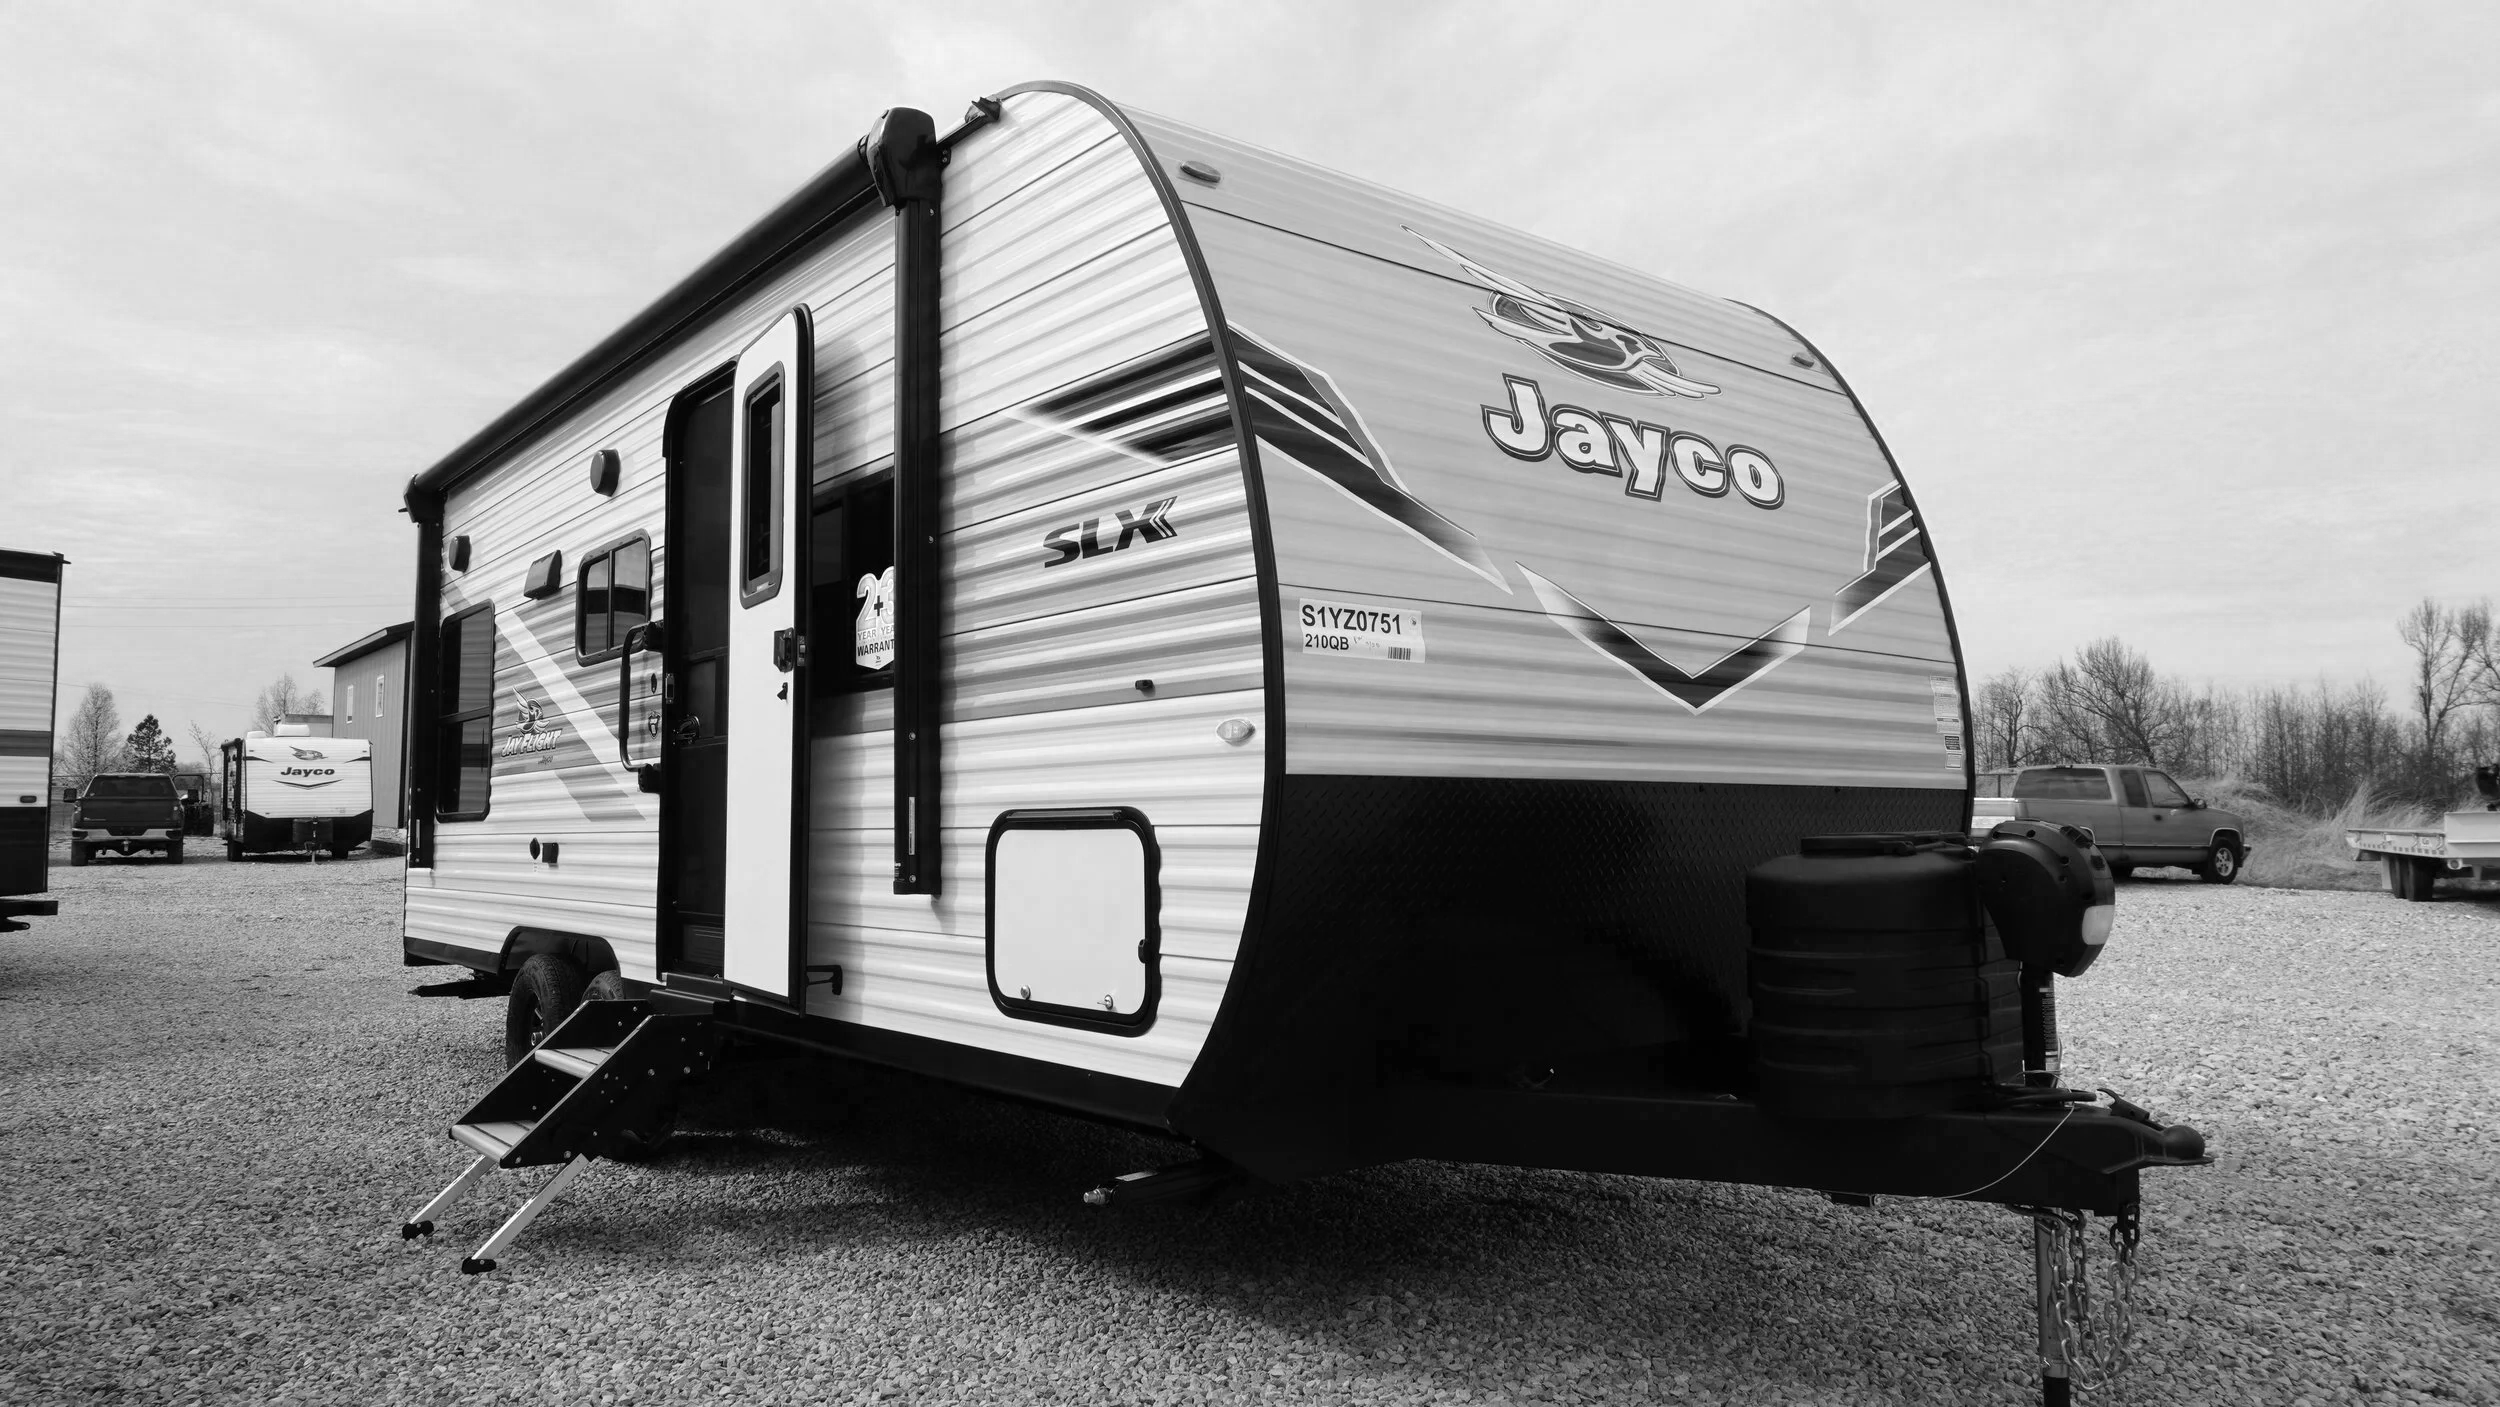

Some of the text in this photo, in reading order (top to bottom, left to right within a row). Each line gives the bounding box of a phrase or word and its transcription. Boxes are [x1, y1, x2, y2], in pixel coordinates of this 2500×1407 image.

[1480, 372, 1785, 510] Jayco
[1043, 496, 1178, 568] SLX
[1302, 604, 1401, 634] S1YZ0751
[857, 629, 877, 641] YEAR
[881, 624, 895, 636] YEA
[1305, 633, 1349, 650] 210QB
[857, 639, 895, 656] WARRANT
[501, 728, 563, 757] JAY FLIGHT
[280, 767, 335, 777] Jayco
